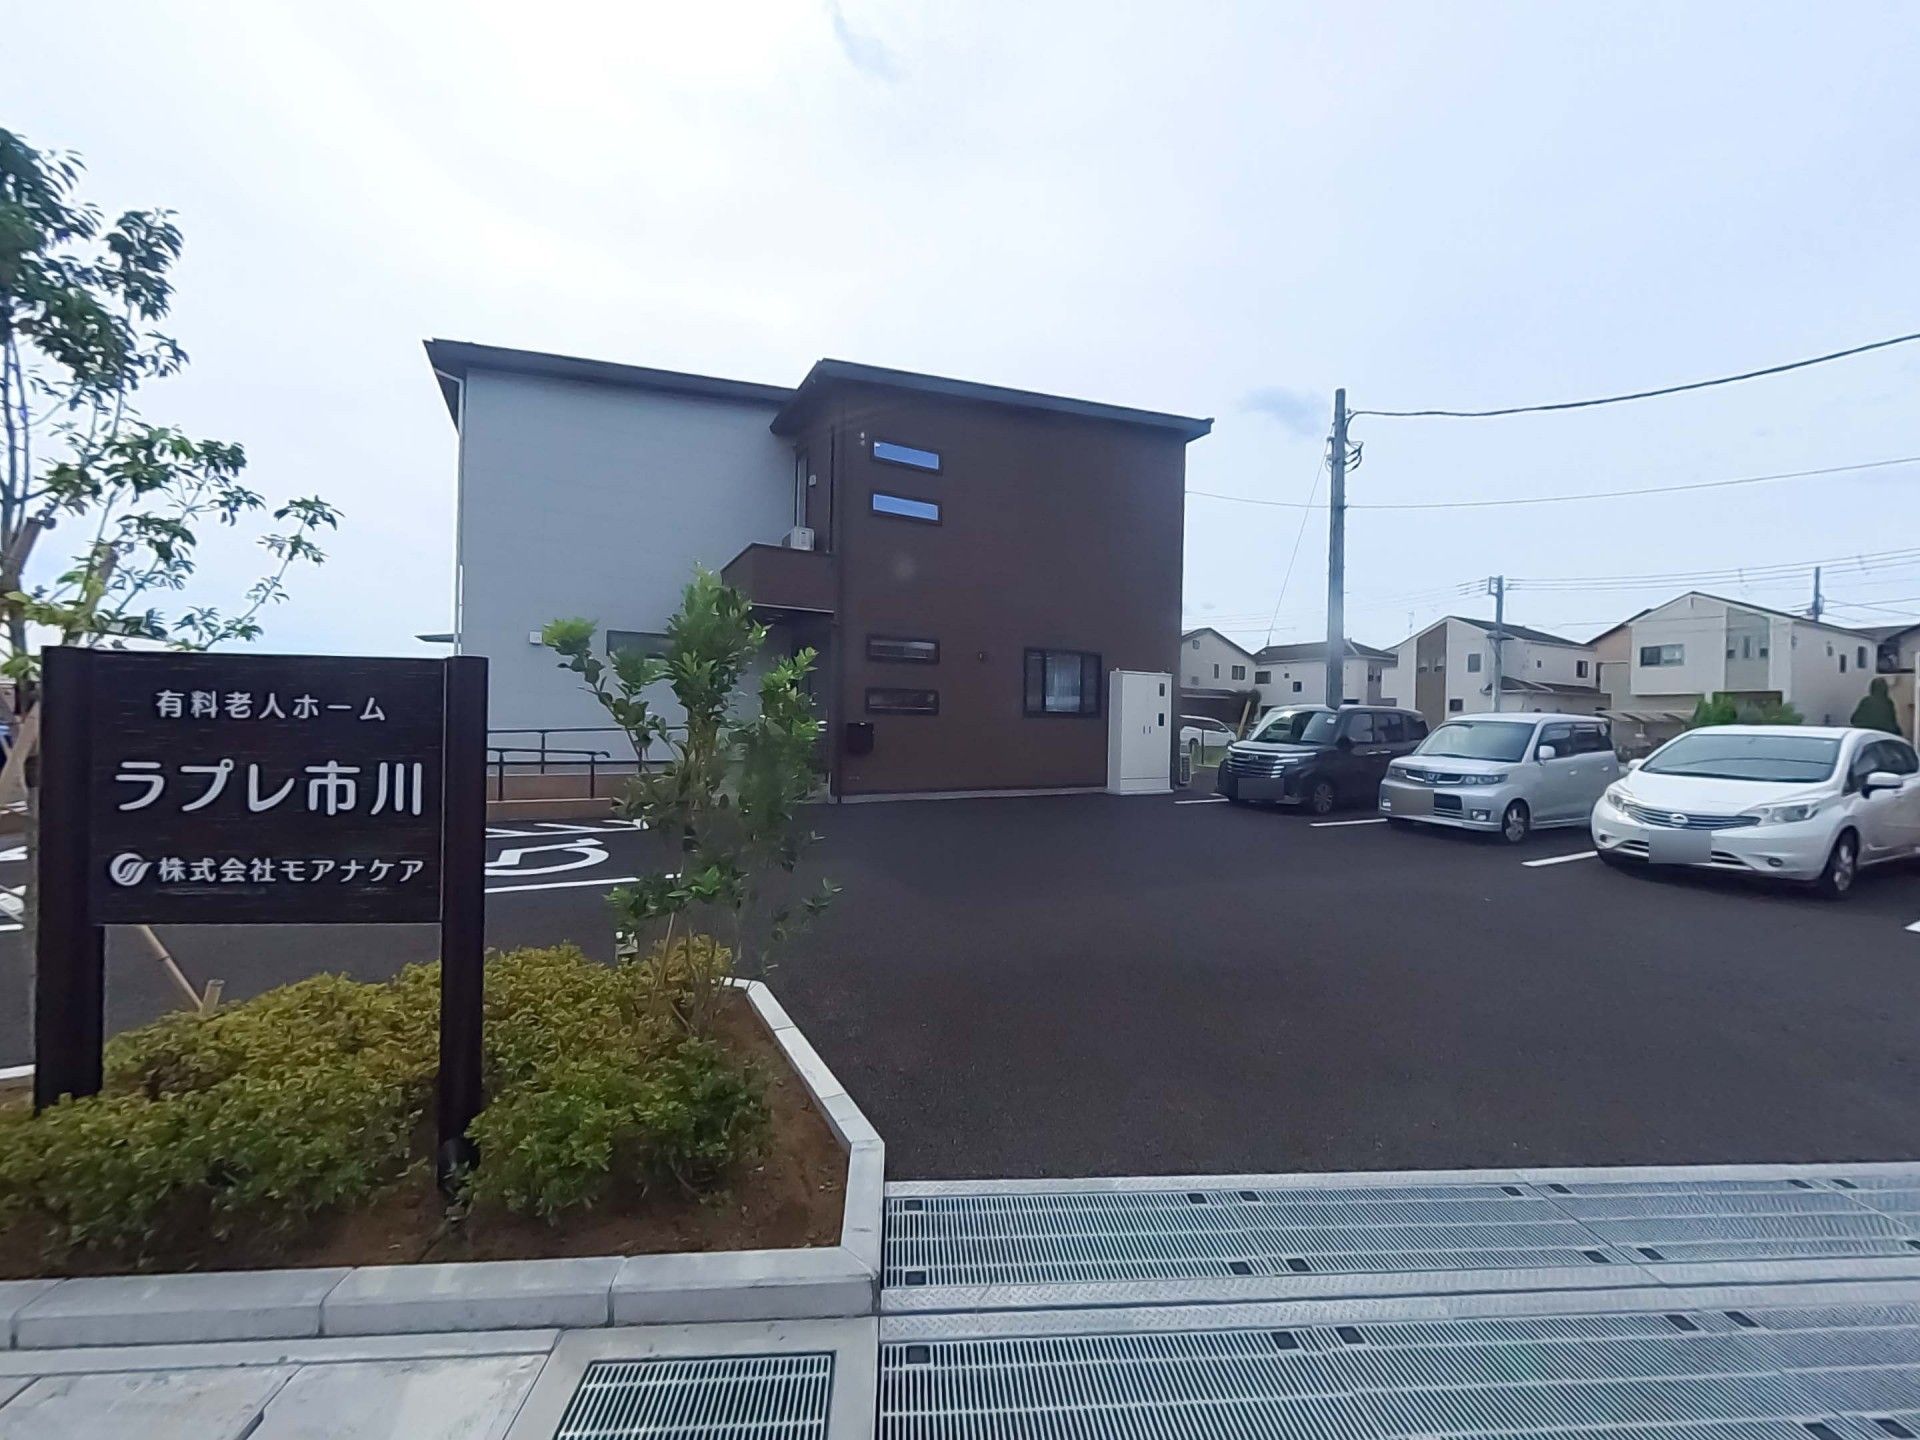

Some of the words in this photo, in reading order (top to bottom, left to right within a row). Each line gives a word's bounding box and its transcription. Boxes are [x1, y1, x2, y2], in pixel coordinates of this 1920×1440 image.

[156, 689, 385, 721] 有料老人ホーム
[115, 758, 422, 816] ラプレ市川
[158, 857, 424, 882] 株式会社モアナケア
